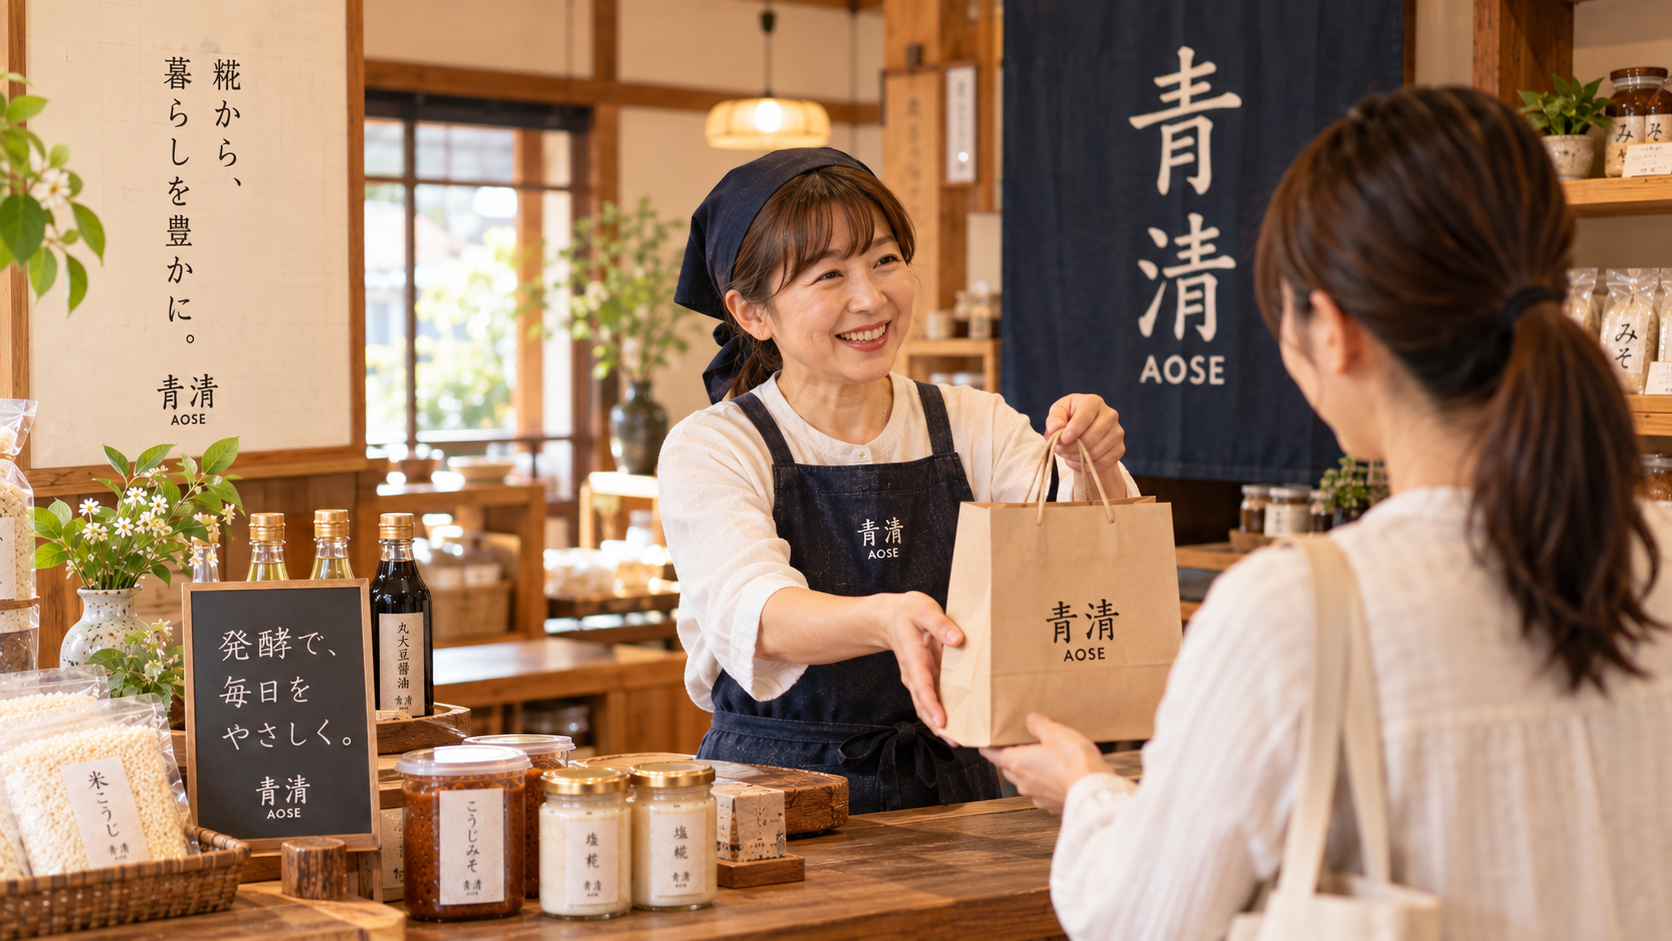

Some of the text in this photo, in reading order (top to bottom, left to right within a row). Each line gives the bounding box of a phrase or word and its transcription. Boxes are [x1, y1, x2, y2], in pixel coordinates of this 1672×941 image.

[212, 59, 242, 187] 糀から、
[163, 56, 195, 344] 暮らしを豊かに。
[1129, 46, 1242, 342] 青清
[1615, 323, 1638, 369] みそ
[1139, 354, 1226, 386] AOSE
[157, 373, 219, 410] 青清
[170, 413, 206, 426] AOSE
[857, 517, 904, 547] 青清
[868, 547, 899, 560] AOSE
[1046, 598, 1120, 644] 青清
[218, 626, 336, 662] 発酵で、
[1063, 647, 1106, 662] AOSE
[219, 675, 310, 709] 毎日を
[222, 718, 352, 751] やさしく。
[88, 770, 120, 838] 米こうじ
[255, 774, 311, 806] 青清
[266, 807, 301, 820] AOSE
[466, 800, 480, 873] こうじみそ
